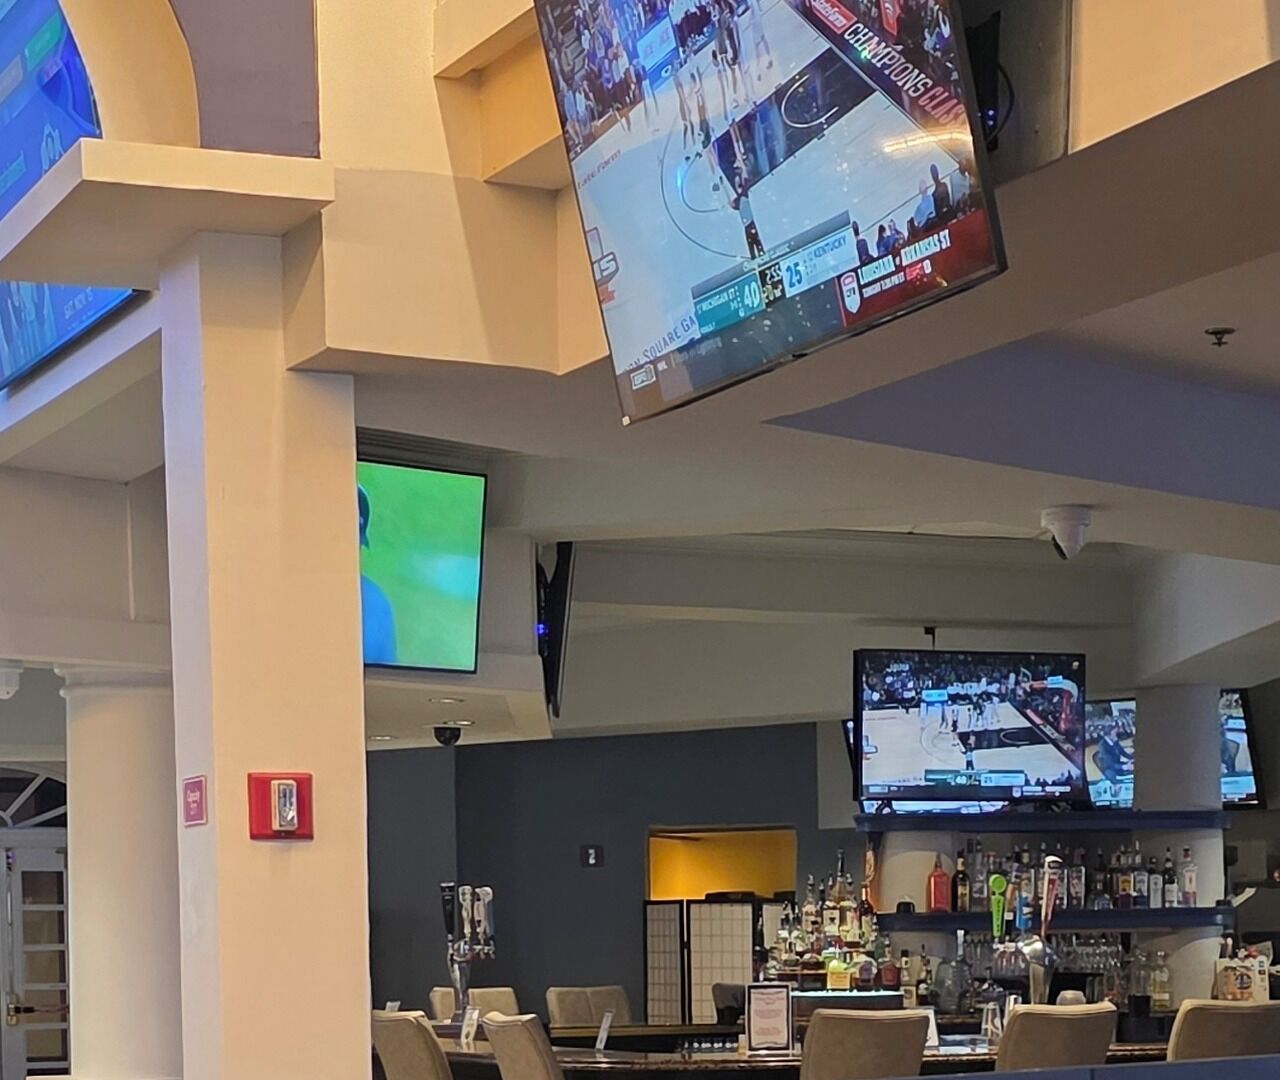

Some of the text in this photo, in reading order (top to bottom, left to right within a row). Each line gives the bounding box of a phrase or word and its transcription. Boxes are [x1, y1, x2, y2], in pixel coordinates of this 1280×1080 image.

[843, 23, 933, 98] CHAMPIONS
[813, 236, 847, 258] KENTUCKY
[786, 262, 803, 289] 25
[744, 281, 760, 308] 40
[643, 326, 681, 363] SQUARE
